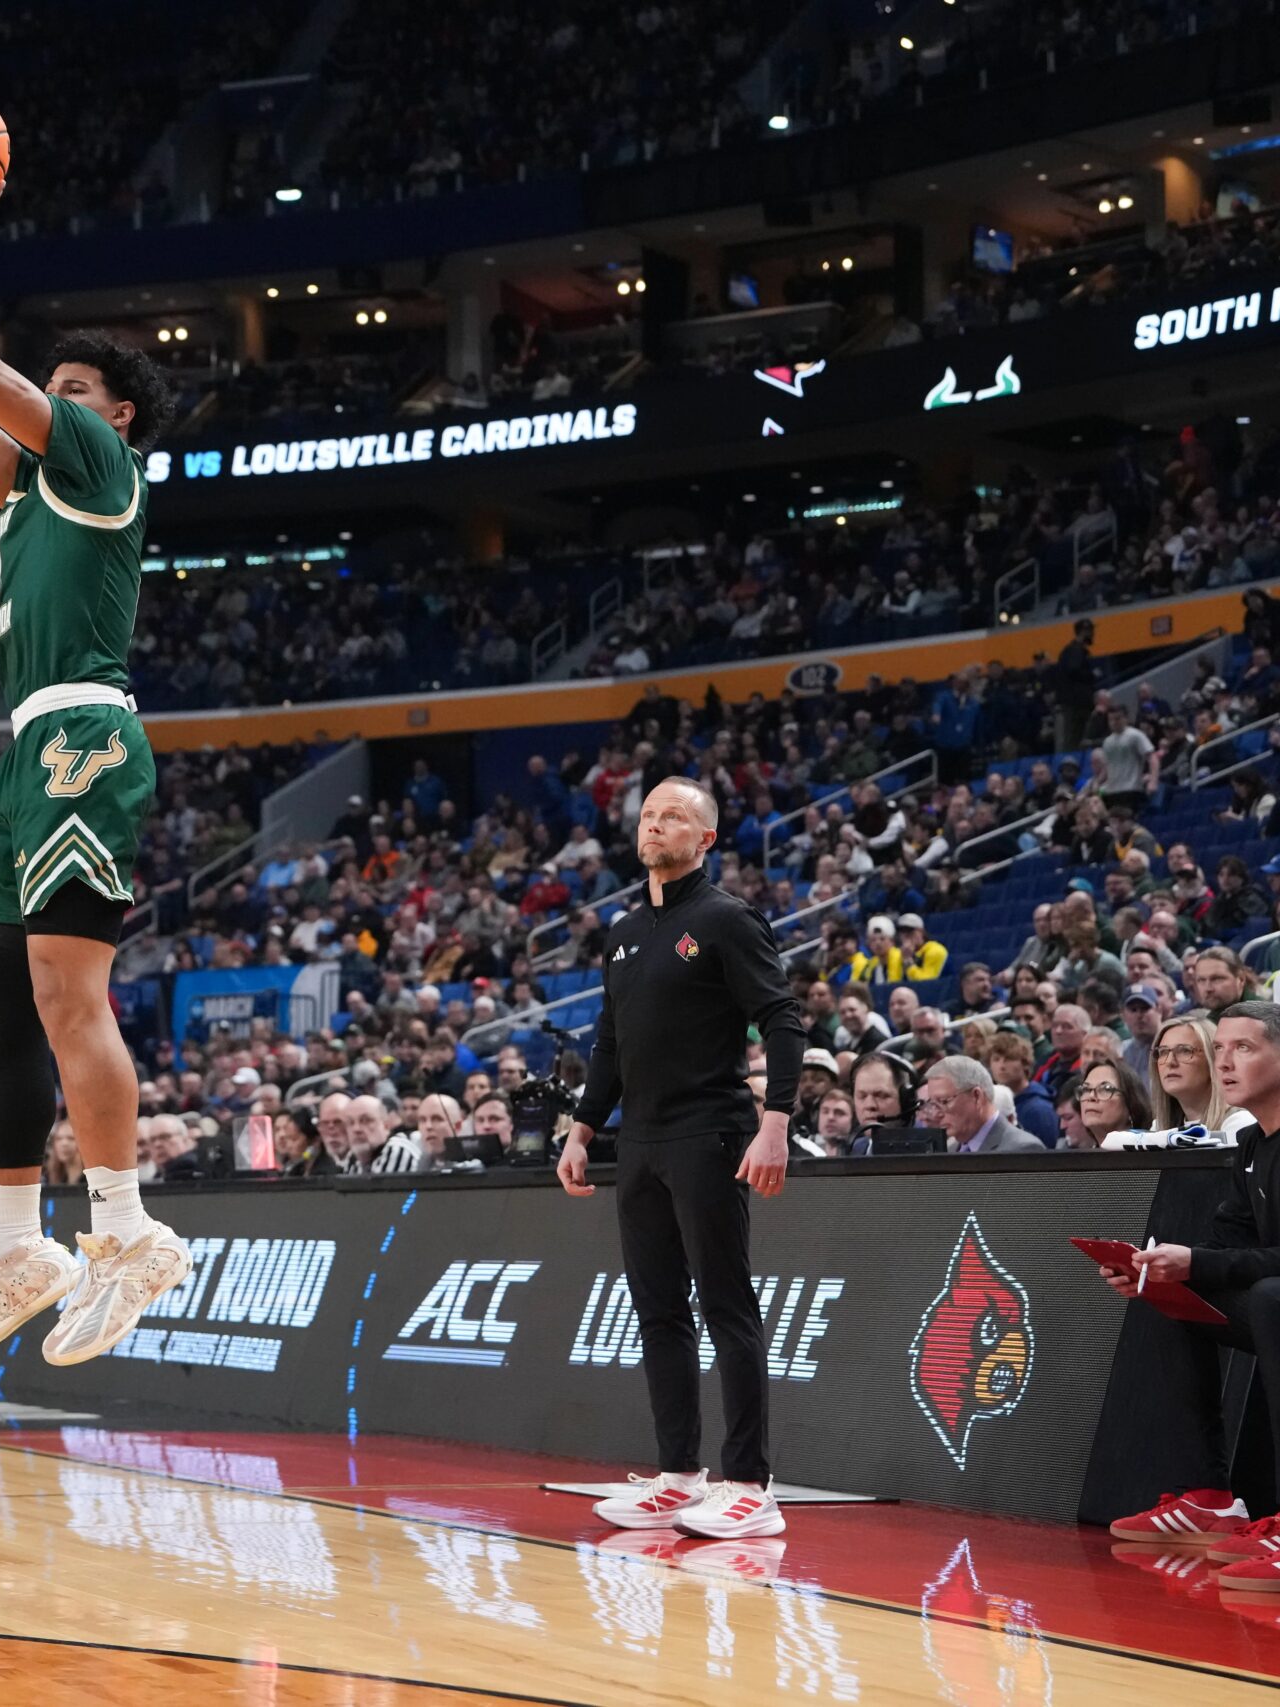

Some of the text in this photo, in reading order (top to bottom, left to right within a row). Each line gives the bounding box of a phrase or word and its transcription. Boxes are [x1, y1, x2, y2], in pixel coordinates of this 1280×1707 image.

[1134, 292, 1261, 350] SOUTH
[184, 451, 222, 478] VS
[231, 429, 435, 477] LOUISVILLE
[440, 403, 637, 458] CARDINALS
[207, 1238, 336, 1328] ROUND
[397, 1260, 543, 1343] ACC
